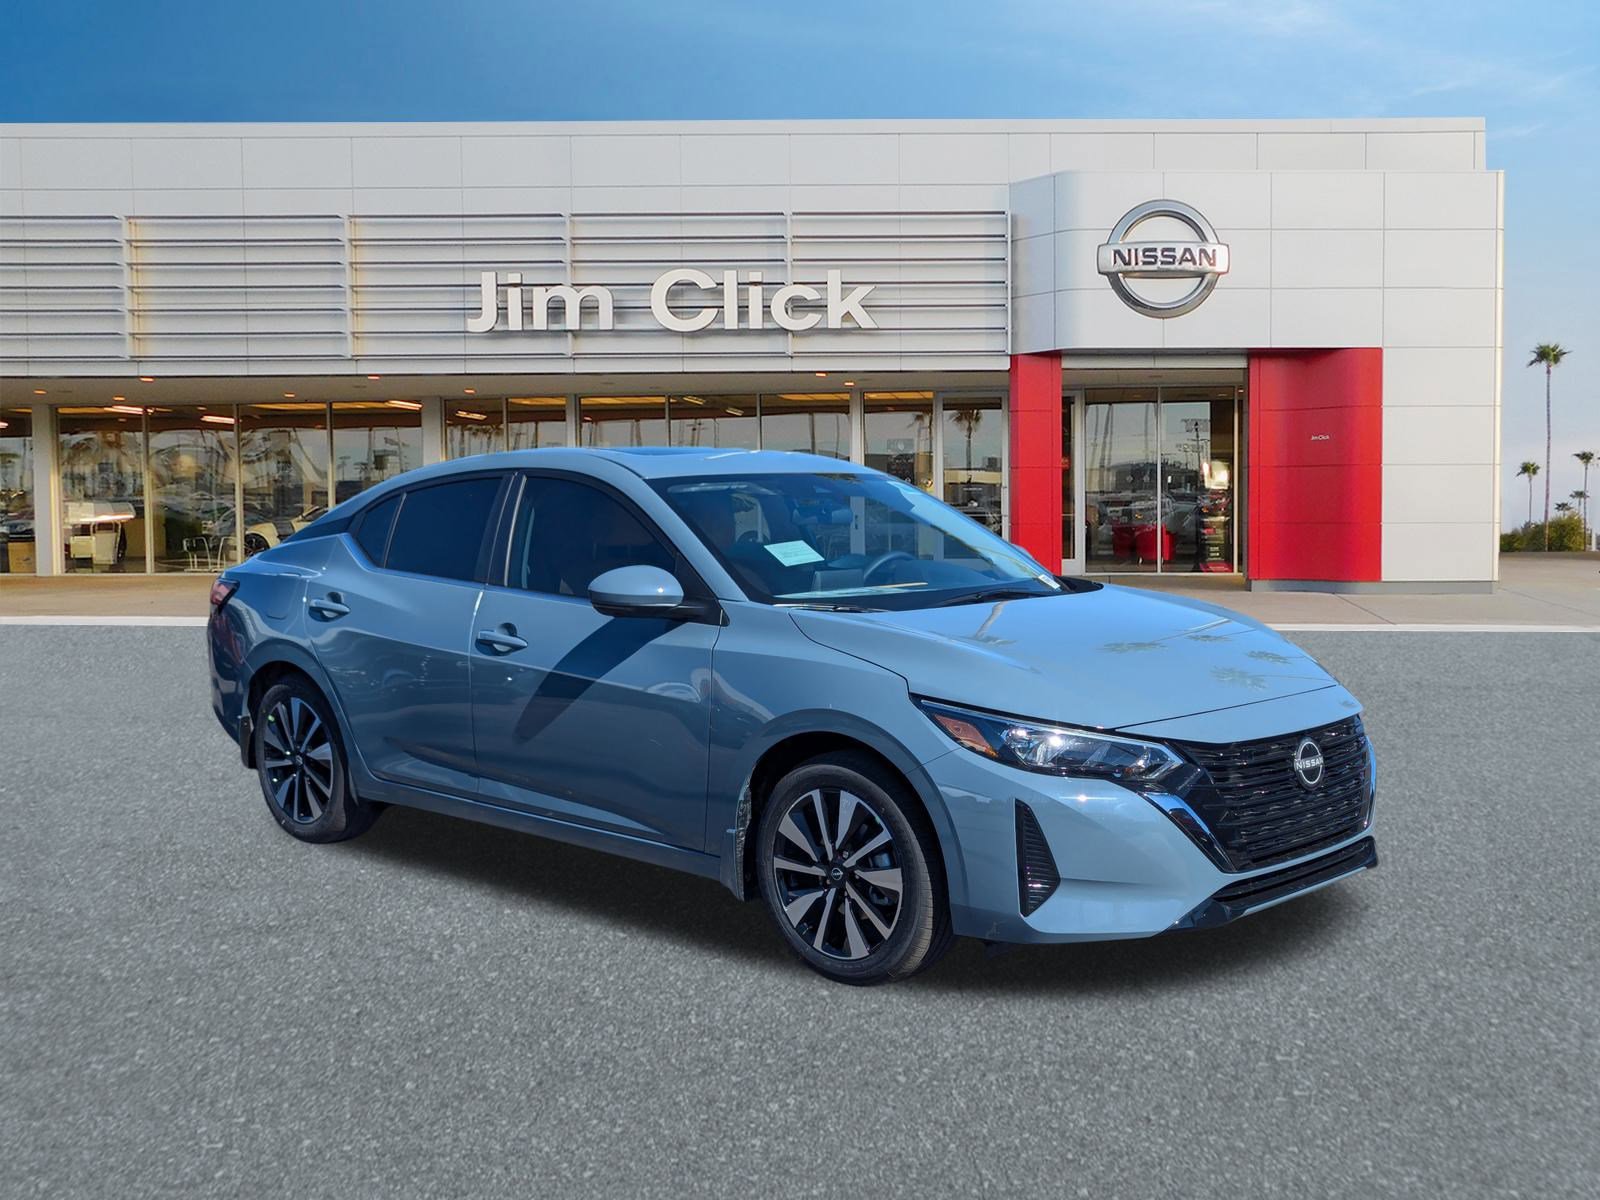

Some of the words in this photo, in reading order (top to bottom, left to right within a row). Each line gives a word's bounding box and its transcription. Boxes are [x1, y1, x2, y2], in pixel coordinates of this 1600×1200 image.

[1112, 247, 1217, 267] NISSAN
[467, 271, 614, 333] Jim
[650, 268, 879, 333] Click
[1296, 756, 1324, 770] NISSAN
